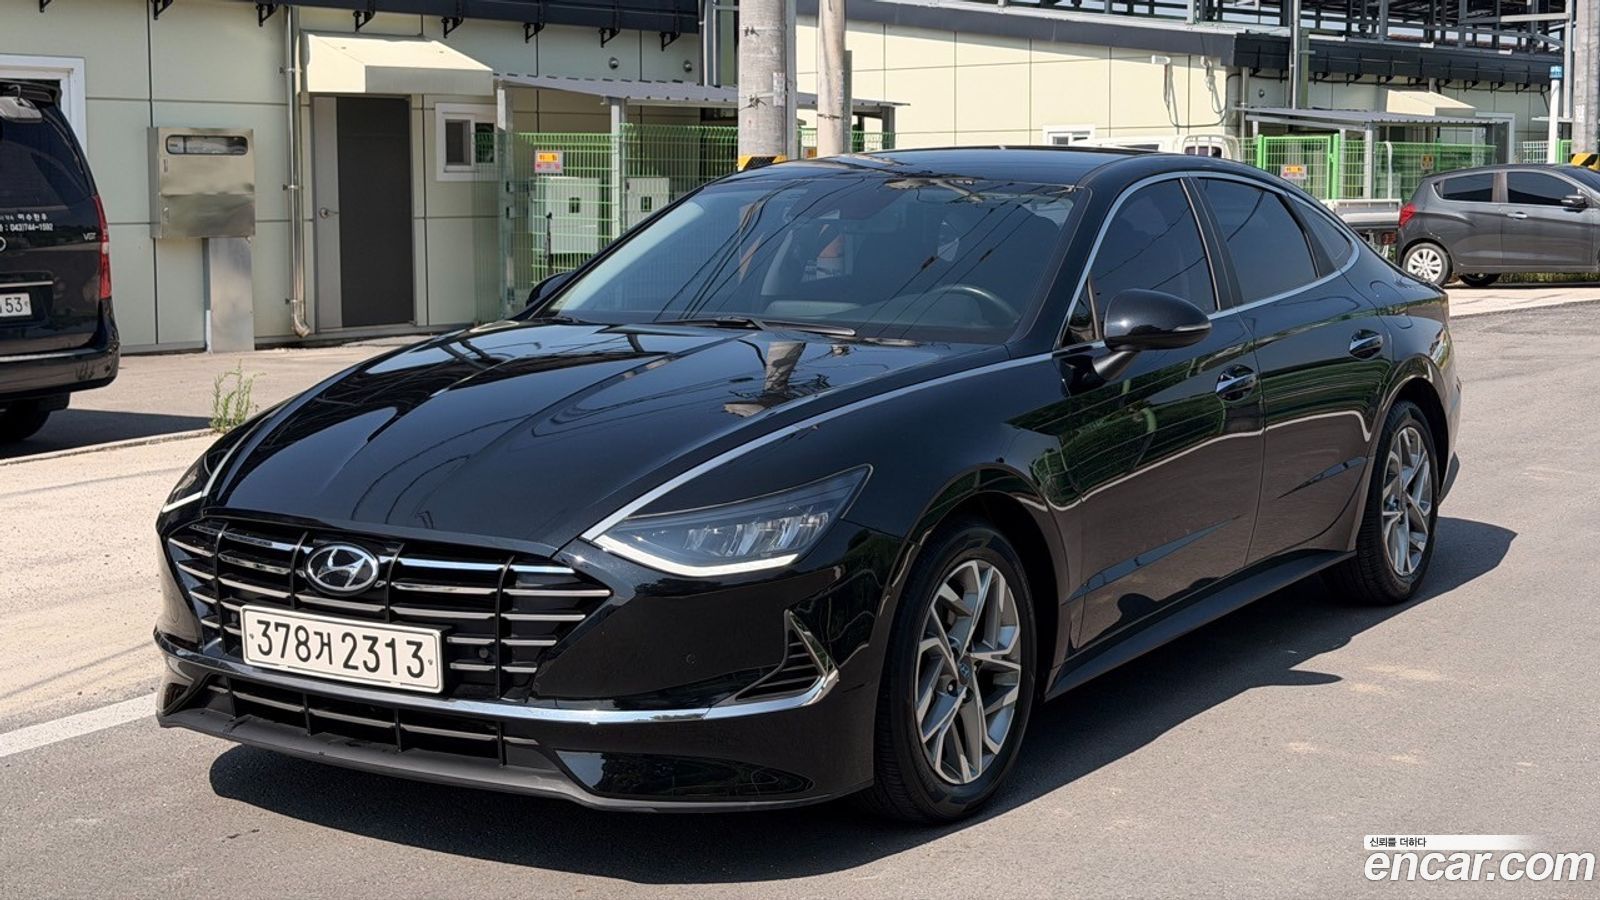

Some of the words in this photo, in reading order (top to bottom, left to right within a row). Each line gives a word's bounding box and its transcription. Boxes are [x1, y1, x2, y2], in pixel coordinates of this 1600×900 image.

[0, 297, 23, 313] 53
[256, 619, 333, 665] 378거
[340, 632, 425, 679] 2313
